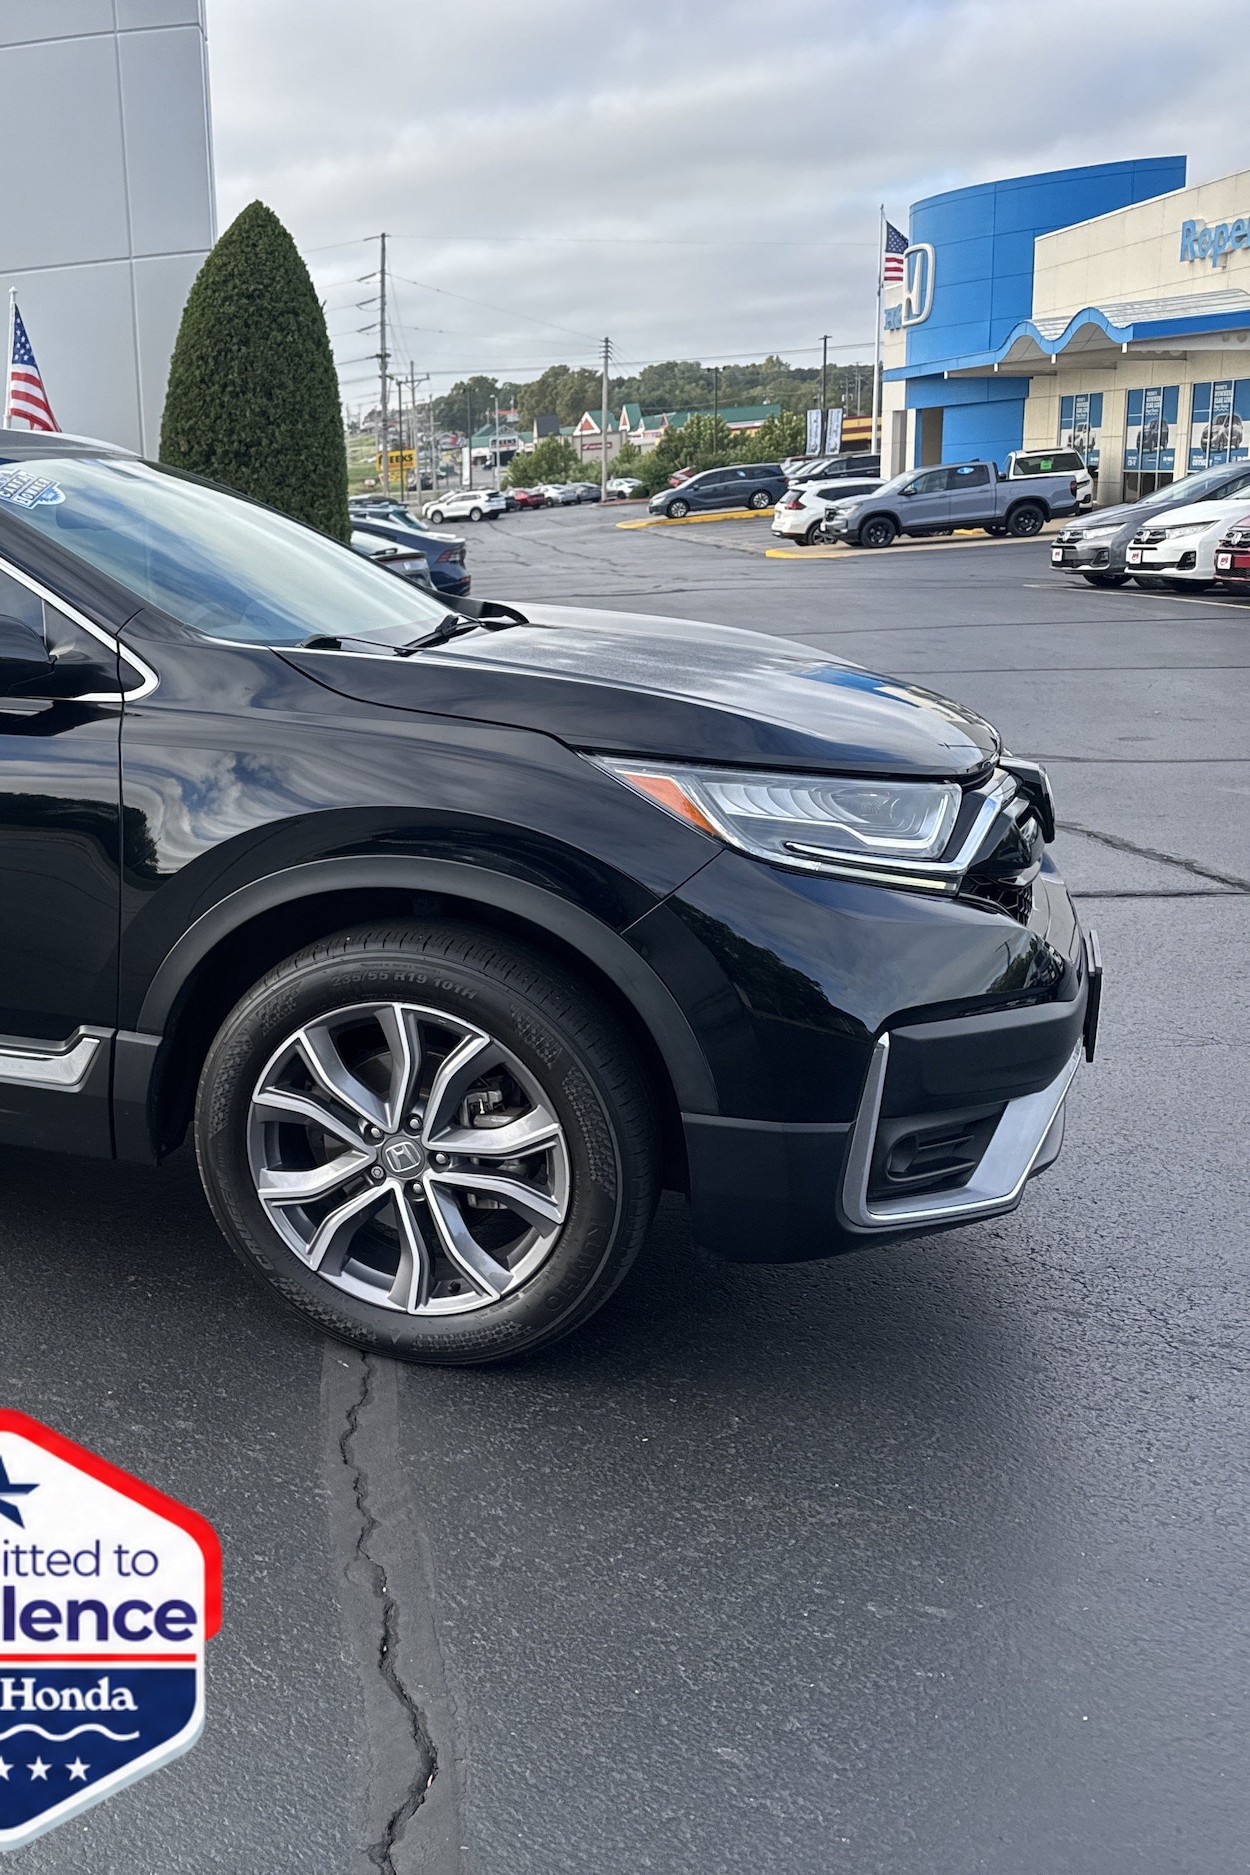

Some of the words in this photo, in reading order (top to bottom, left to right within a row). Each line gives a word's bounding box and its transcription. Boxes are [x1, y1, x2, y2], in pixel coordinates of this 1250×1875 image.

[331, 969, 390, 988] 235/55
[393, 970, 428, 984] R19
[433, 976, 478, 1000] 101H
